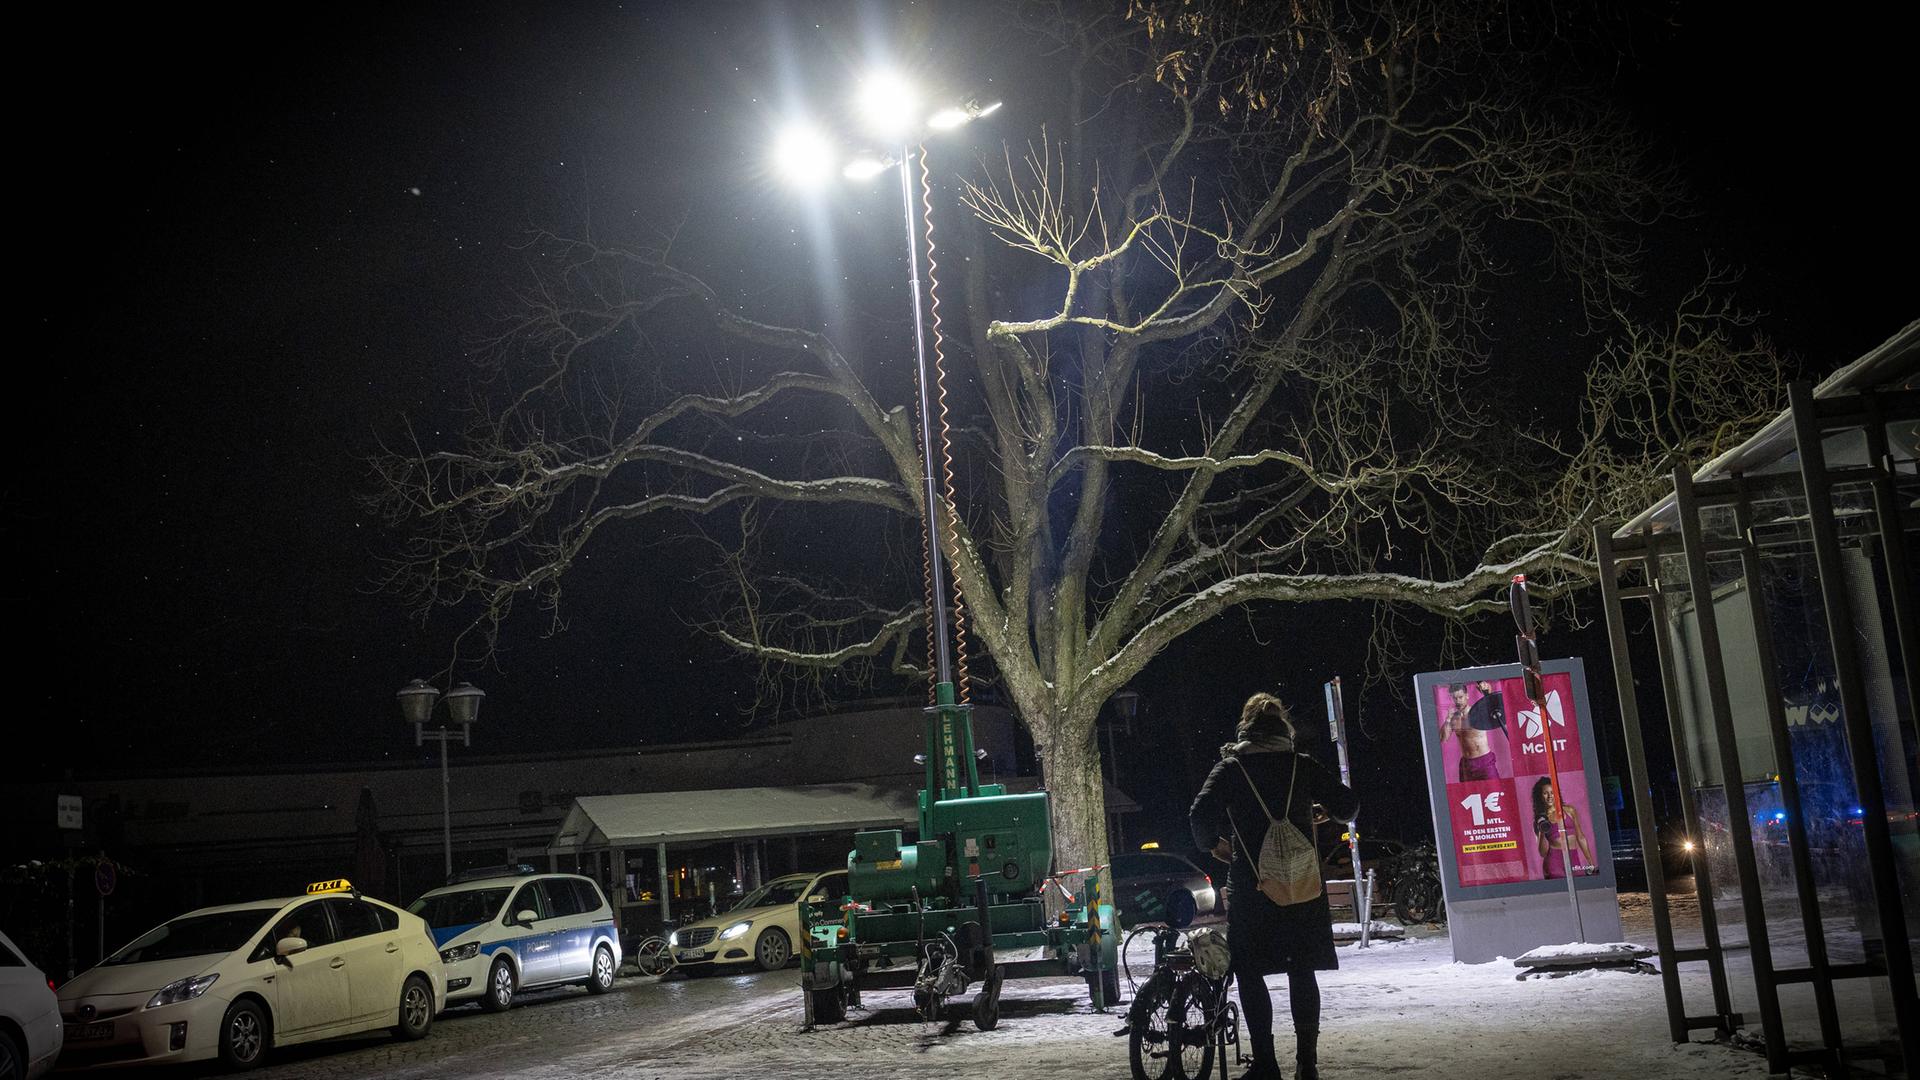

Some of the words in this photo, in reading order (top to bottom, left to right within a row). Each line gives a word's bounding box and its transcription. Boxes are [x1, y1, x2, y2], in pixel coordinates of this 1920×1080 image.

[943, 713, 956, 790] LEHMANN
[1522, 739, 1567, 754] McIT
[1475, 832, 1508, 841] MONATEN
[313, 880, 337, 892] TAXI
